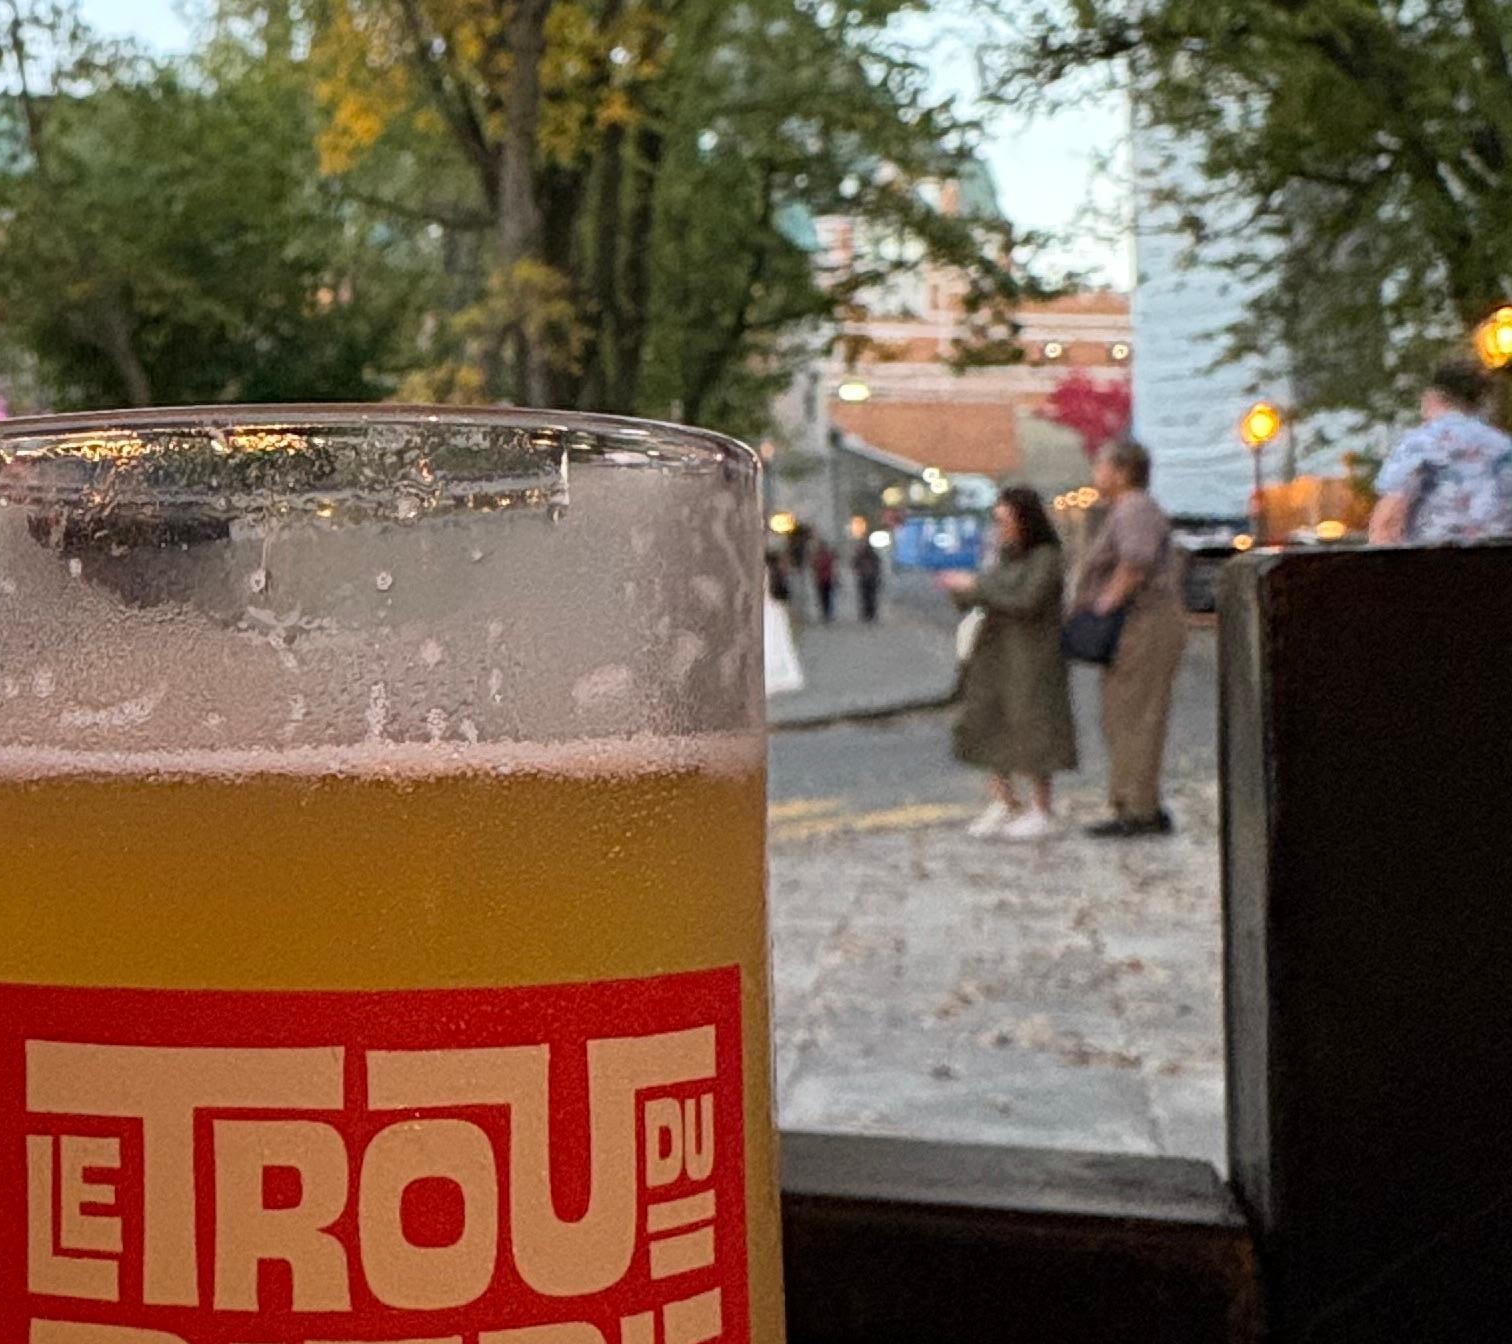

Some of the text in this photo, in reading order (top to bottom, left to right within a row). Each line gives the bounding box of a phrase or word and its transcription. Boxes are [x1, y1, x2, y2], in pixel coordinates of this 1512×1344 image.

[25, 1025, 717, 1313] LE TROU DU
